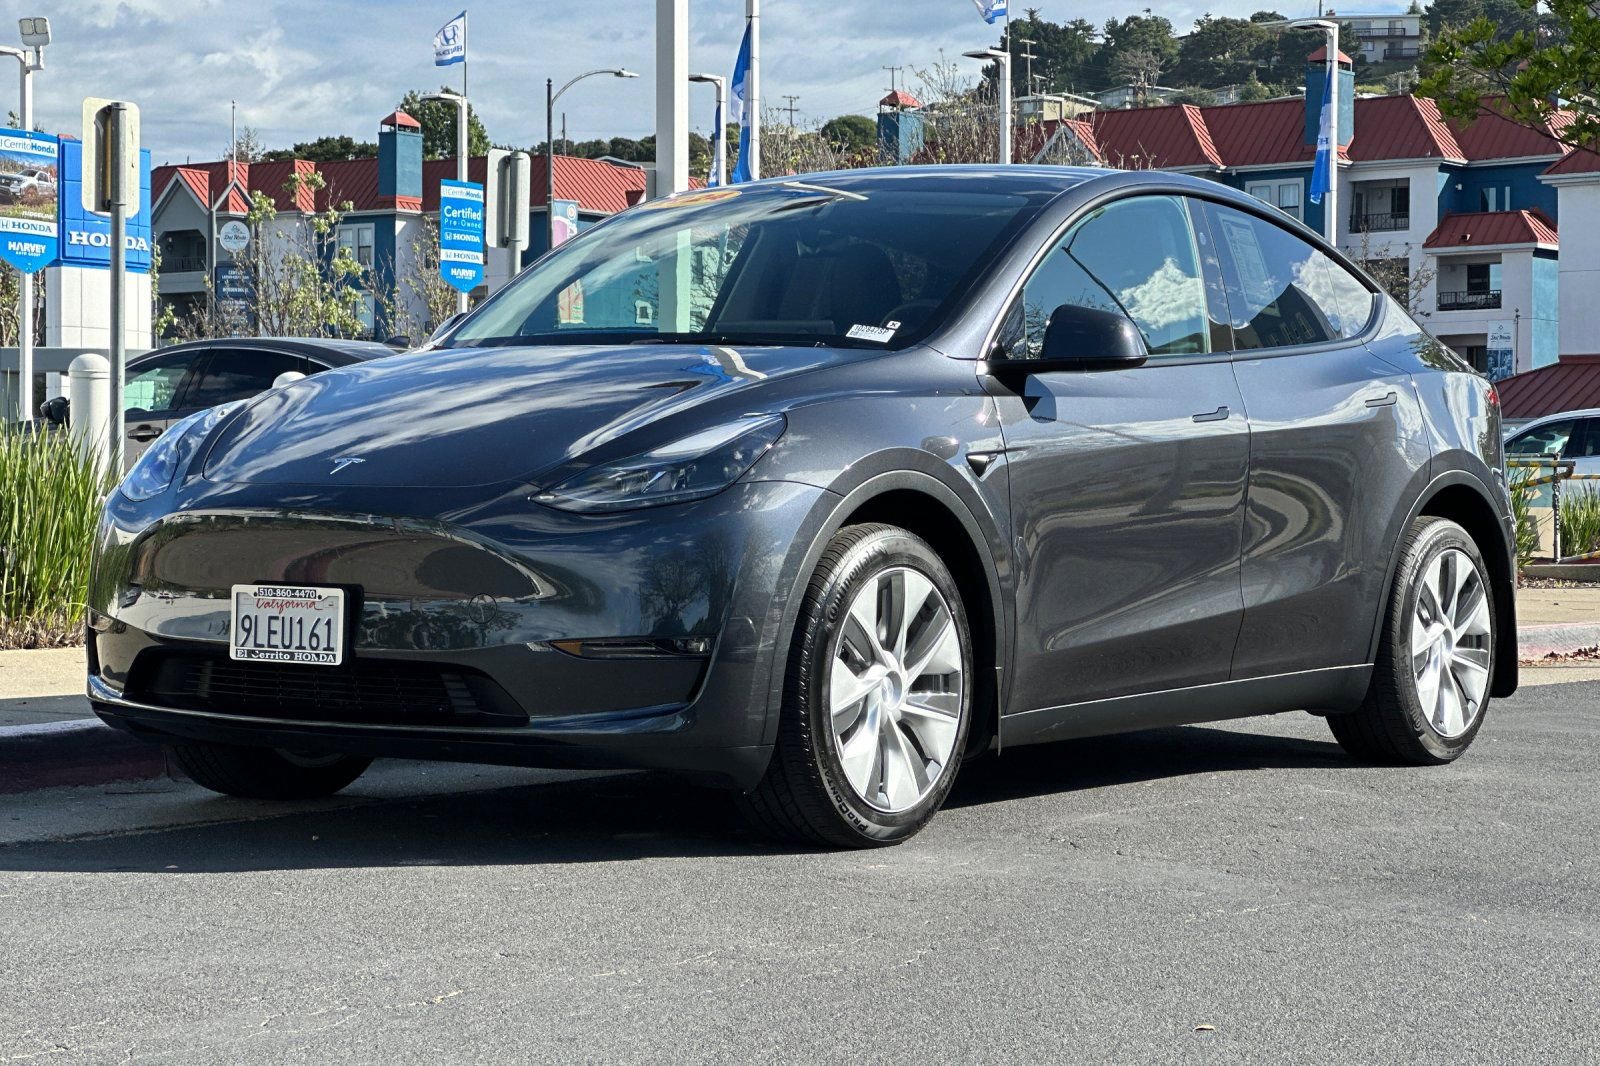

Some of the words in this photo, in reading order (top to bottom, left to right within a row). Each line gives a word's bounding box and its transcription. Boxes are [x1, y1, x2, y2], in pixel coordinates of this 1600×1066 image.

[444, 205, 482, 221] Certified
[12, 221, 53, 233] HONDA
[445, 218, 482, 229] Pre-Owned
[69, 231, 150, 251] HODA
[453, 233, 481, 243] HONDA
[8, 241, 47, 254] HARVEY
[453, 252, 480, 261] HONDA
[259, 588, 316, 599] 510-860-4470
[256, 598, 323, 614] California
[241, 614, 335, 652] 9LEU161
[236, 649, 248, 658] El
[294, 652, 335, 663] HONDA
